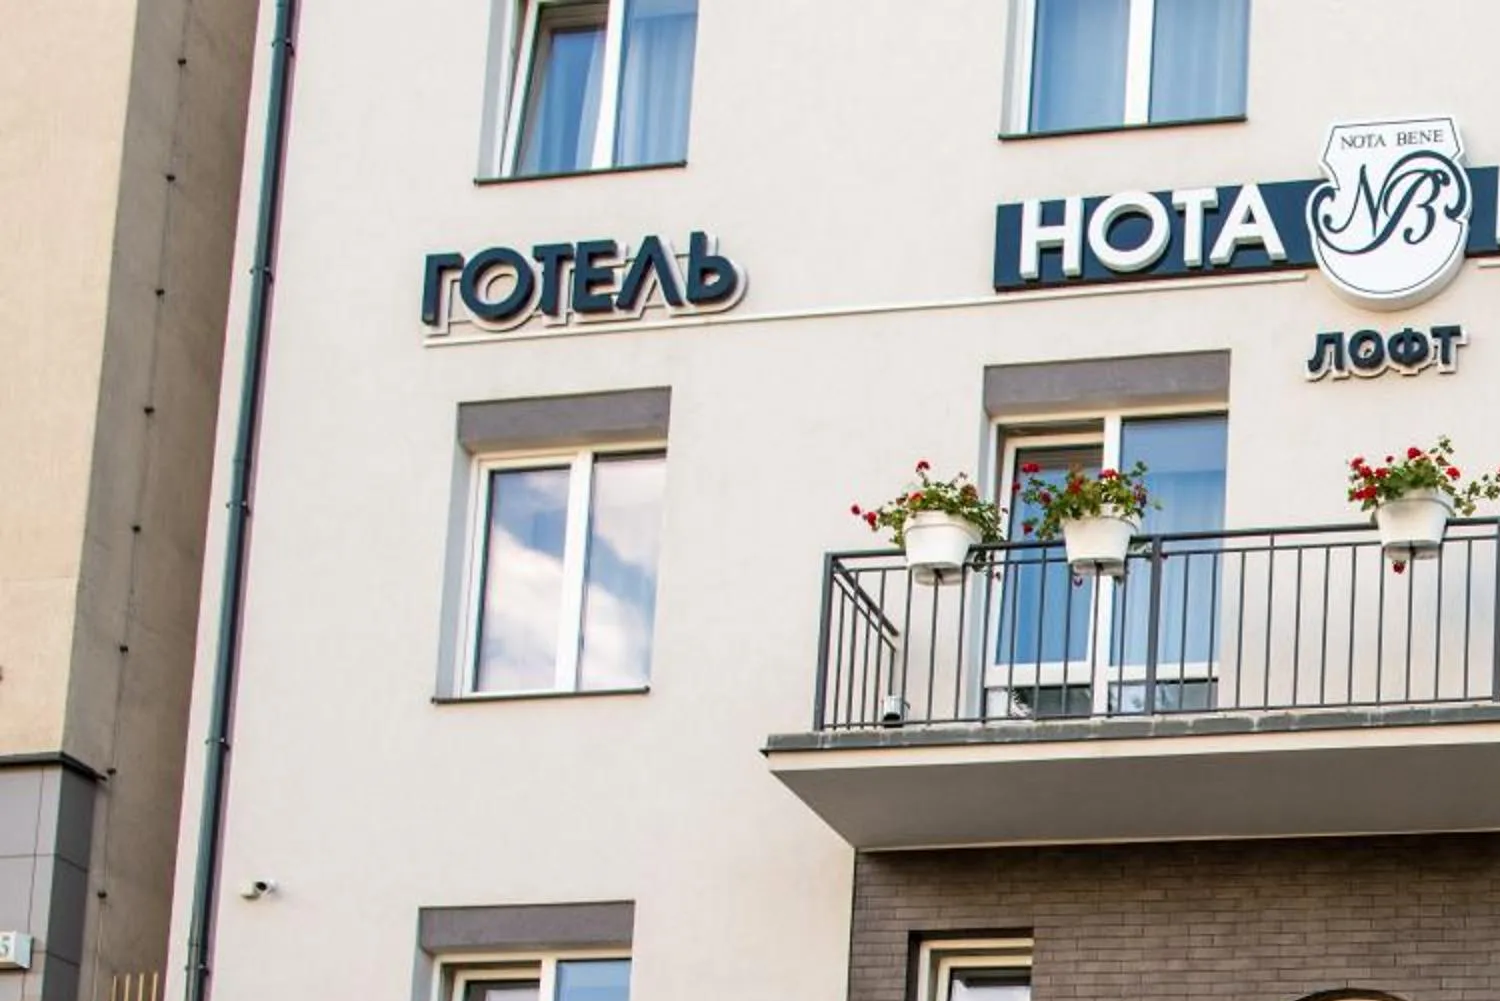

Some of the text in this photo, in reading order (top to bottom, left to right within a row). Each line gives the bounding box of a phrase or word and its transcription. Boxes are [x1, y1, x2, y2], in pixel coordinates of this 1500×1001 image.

[1340, 129, 1444, 149] NOTA BENE
[1018, 182, 1288, 280] НОТА
[421, 231, 740, 328] ГОТЕЛЬ
[1306, 324, 1463, 375] ЛОФТ
